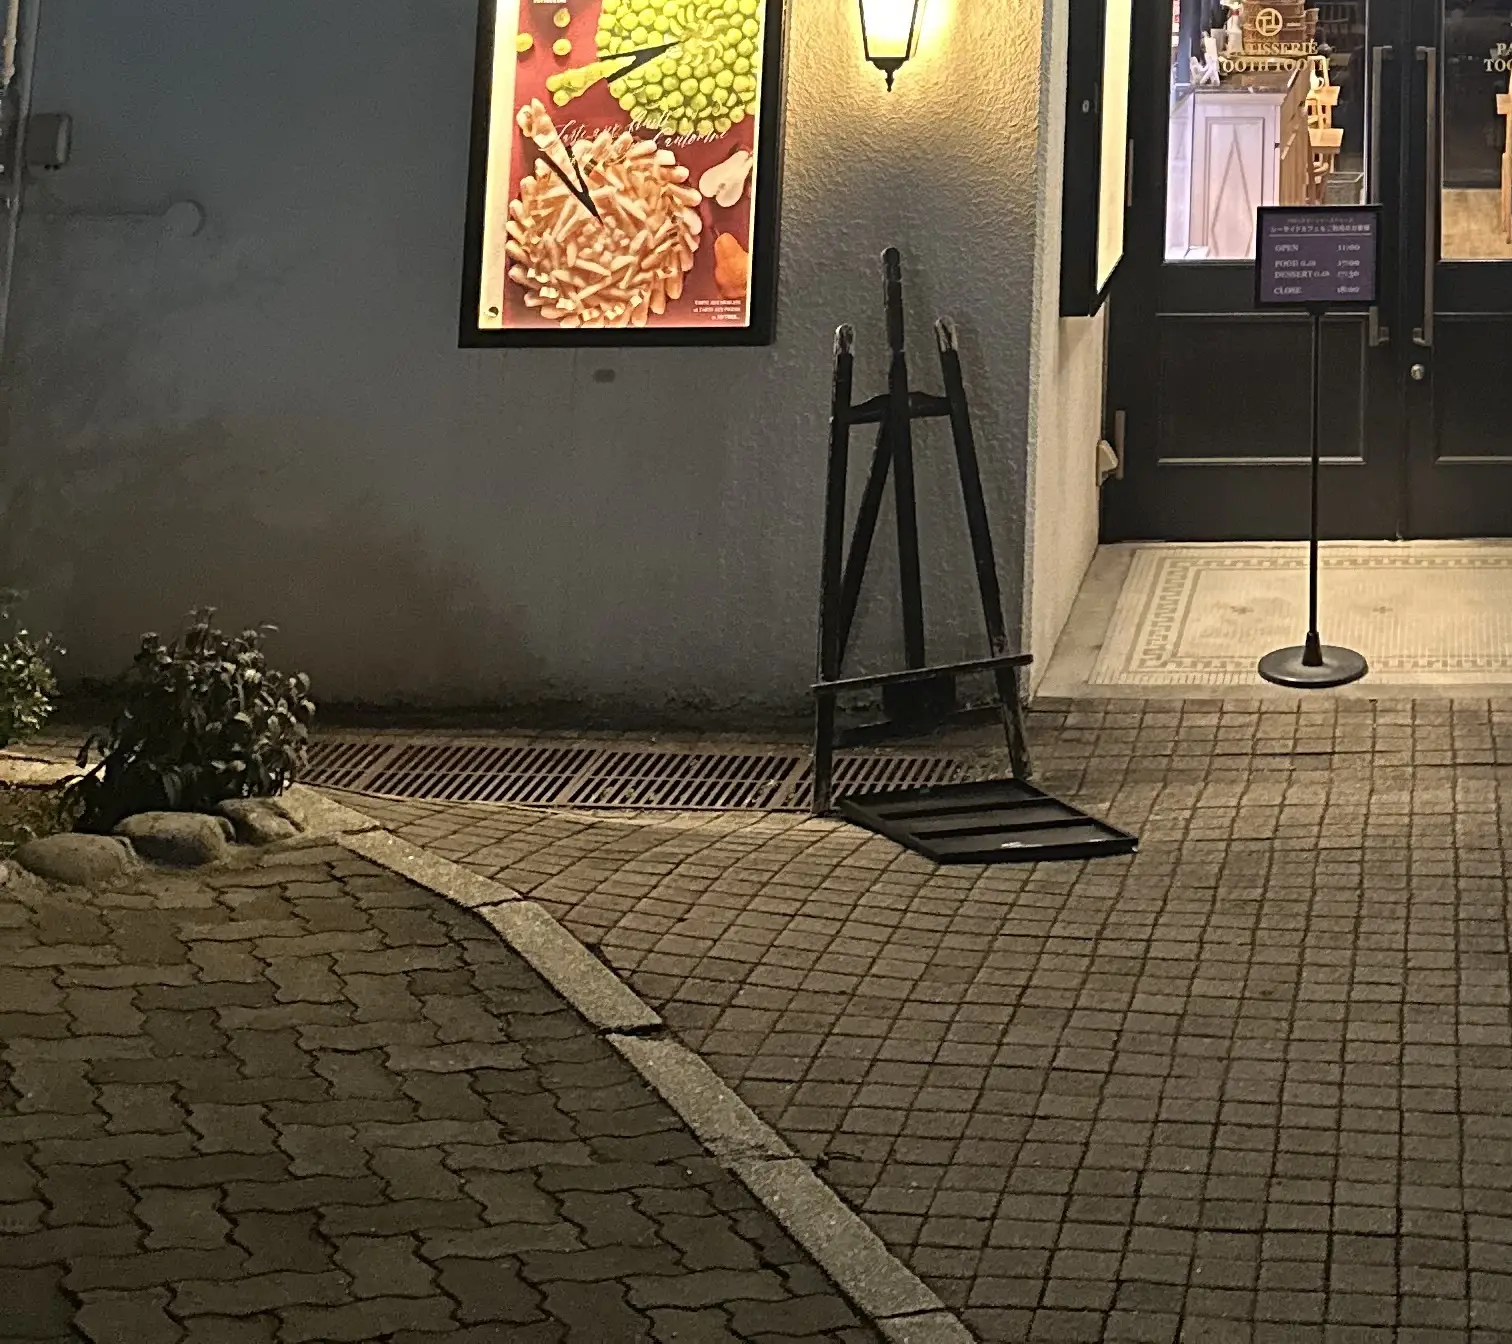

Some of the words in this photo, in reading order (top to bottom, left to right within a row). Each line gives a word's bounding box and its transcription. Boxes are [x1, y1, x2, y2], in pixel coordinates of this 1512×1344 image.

[1275, 244, 1299, 252] OPEN
[1275, 270, 1312, 278] DESSERT
[1273, 286, 1302, 294] CLOSE
